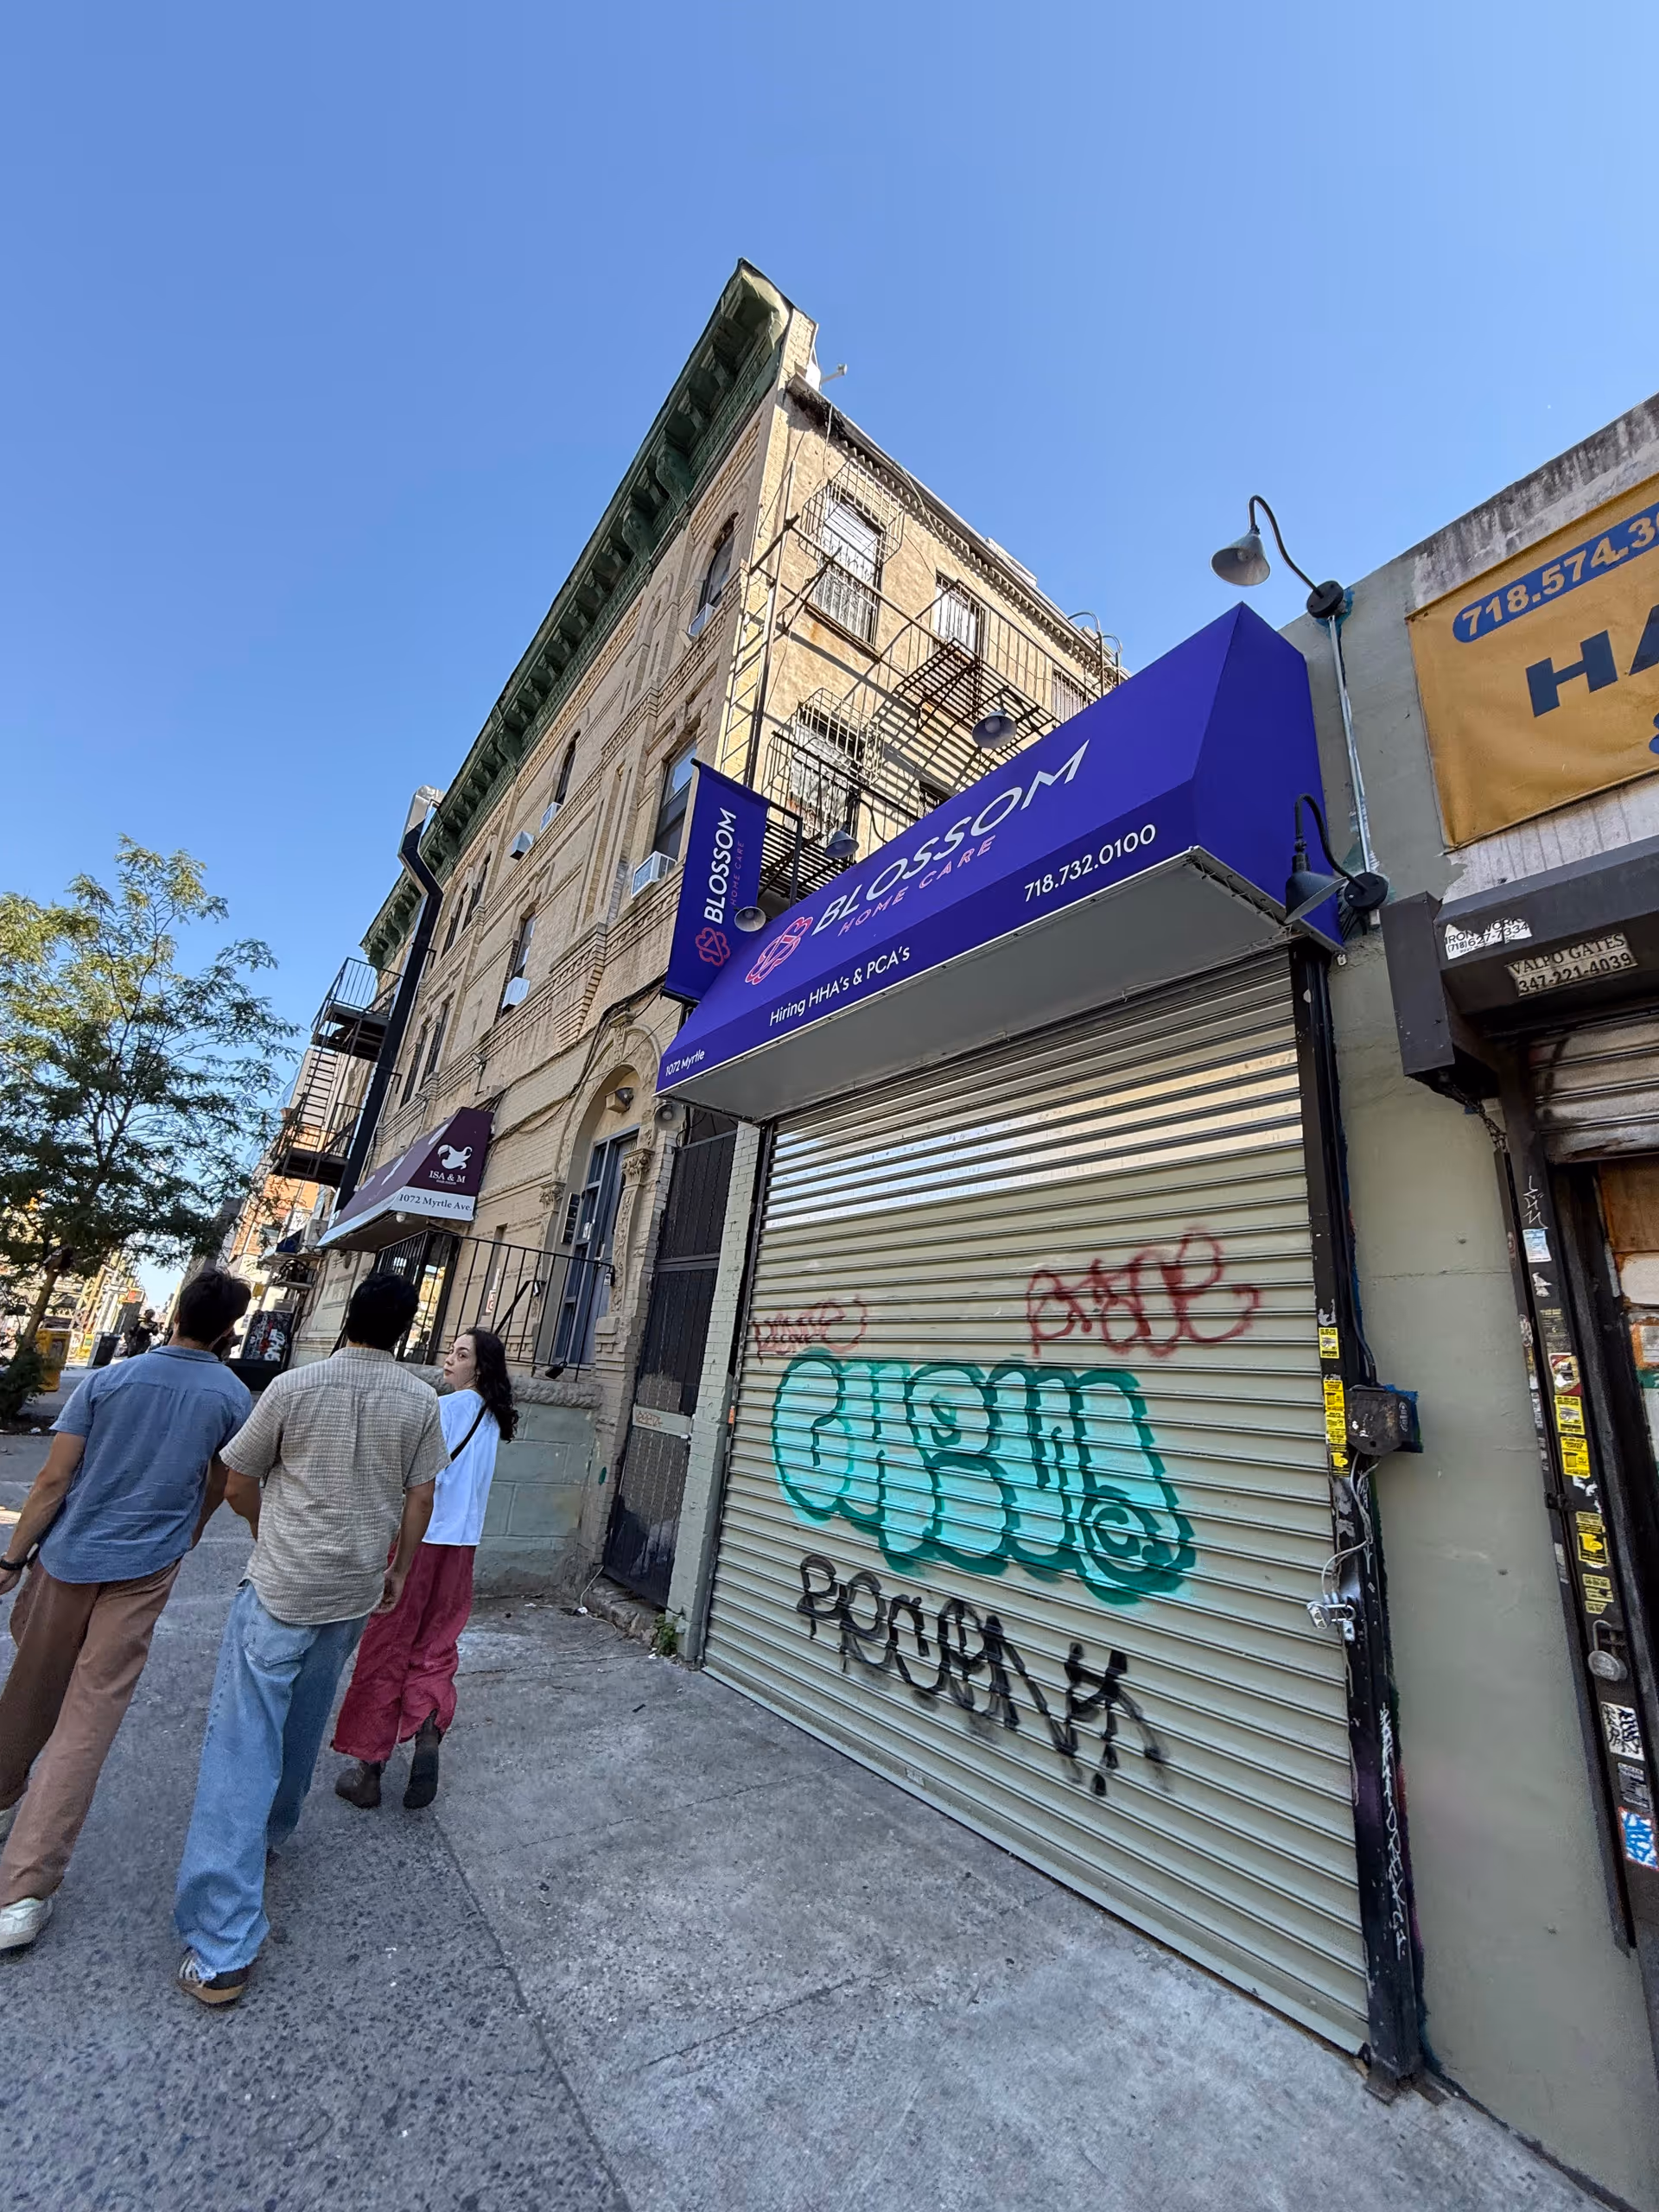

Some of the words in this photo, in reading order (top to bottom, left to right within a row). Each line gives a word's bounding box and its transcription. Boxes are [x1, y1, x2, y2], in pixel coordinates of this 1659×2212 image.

[735, 841, 744, 870] CARE
[811, 738, 1090, 936] BLOSSOM
[703, 807, 737, 925] BLOSSOM
[1024, 823, 1156, 902] 718.732.0100
[730, 874, 741, 906] HOME
[837, 886, 909, 937] HOME
[918, 835, 995, 889] CARE
[1510, 952, 1564, 976] VALPO
[1568, 933, 1625, 959] GATES
[1518, 952, 1632, 993] 347-221-4039
[769, 999, 806, 1026] Hiring
[808, 976, 849, 1008] HHA's
[853, 968, 863, 986] &
[867, 946, 911, 980] PCA's
[665, 1059, 681, 1077] 1072
[681, 1049, 705, 1070] Myrtle
[429, 1170, 445, 1181] ISA
[447, 1173, 454, 1182] &
[456, 1174, 466, 1184] M
[399, 1193, 421, 1205] 1072
[423, 1197, 452, 1209] Myrtle
[454, 1202, 473, 1211] Ave.
